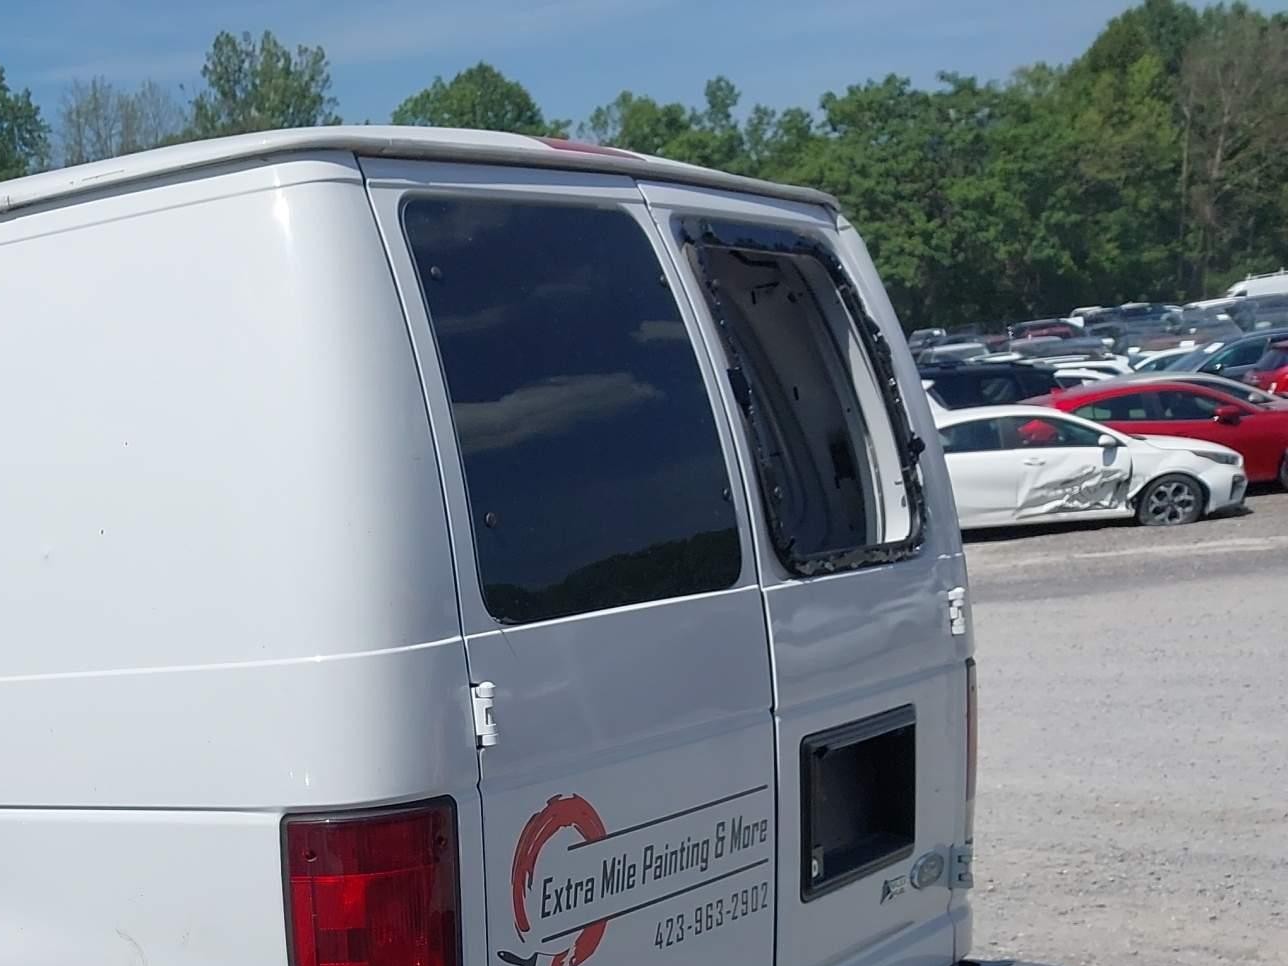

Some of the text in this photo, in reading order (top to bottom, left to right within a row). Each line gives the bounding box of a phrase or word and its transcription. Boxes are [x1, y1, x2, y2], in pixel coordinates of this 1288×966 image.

[541, 815, 768, 919] Extra Mile Painting & More
[654, 882, 769, 949] 423-963-2902
